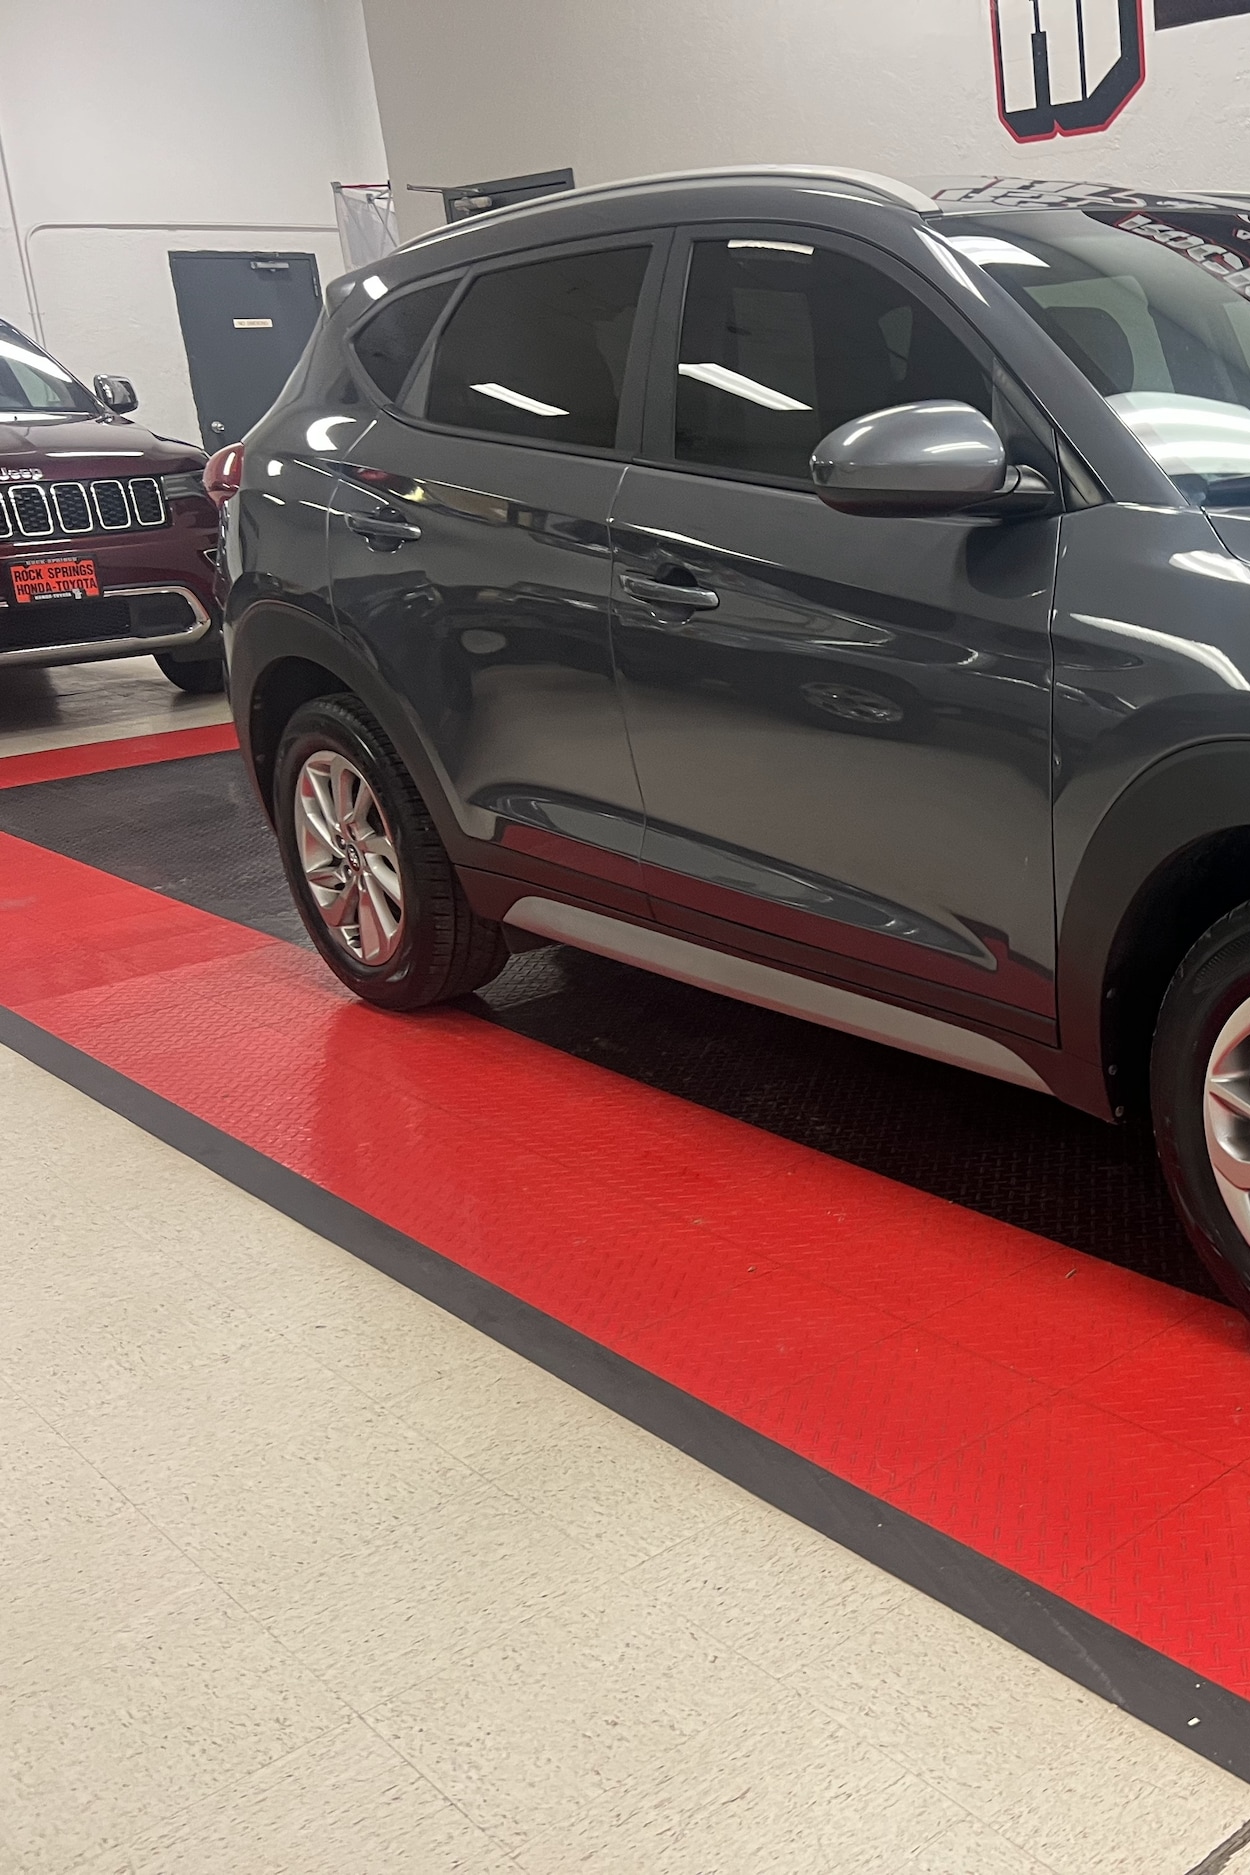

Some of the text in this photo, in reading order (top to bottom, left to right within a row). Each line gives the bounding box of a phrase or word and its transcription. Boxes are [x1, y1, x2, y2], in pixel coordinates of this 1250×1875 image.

[0, 467, 43, 480] Jeep
[14, 564, 93, 582] ROCK SPRINGS
[16, 578, 97, 595] HONDA-TOYOTA
